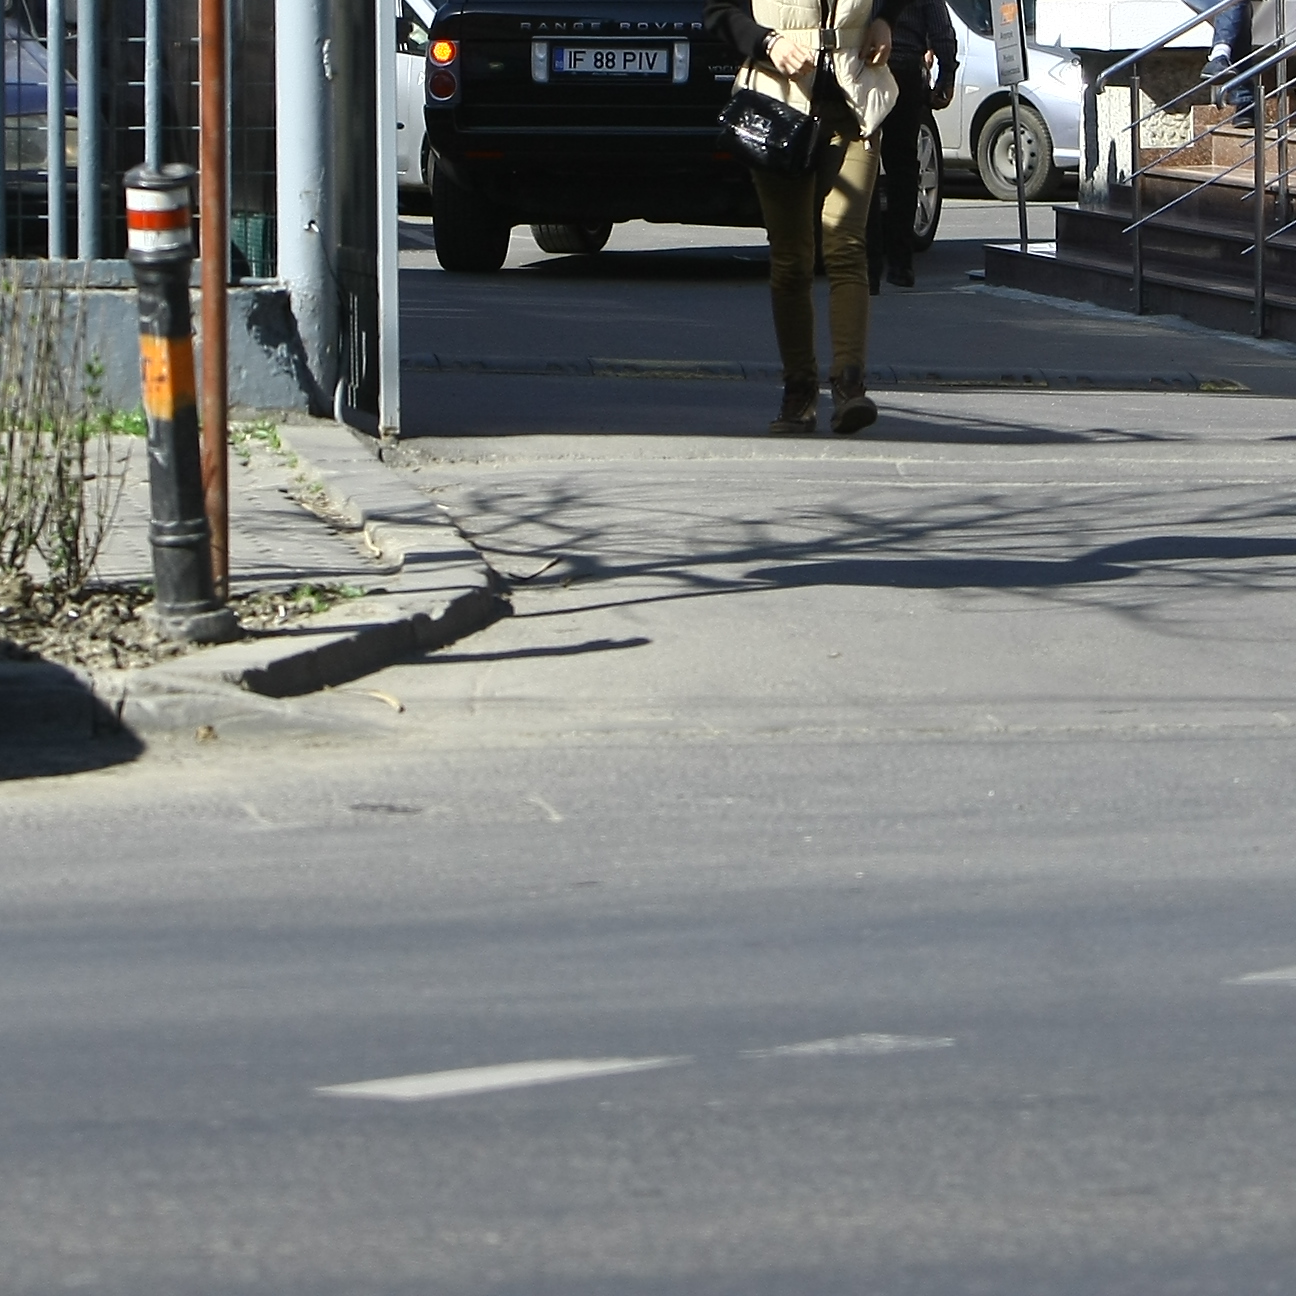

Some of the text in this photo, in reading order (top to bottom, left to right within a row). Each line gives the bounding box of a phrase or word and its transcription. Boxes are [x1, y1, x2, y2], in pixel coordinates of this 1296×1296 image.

[519, 21, 703, 31] RANGE ROVER
[568, 50, 587, 69] IF
[593, 50, 616, 70] 88
[622, 51, 658, 71] PIV
